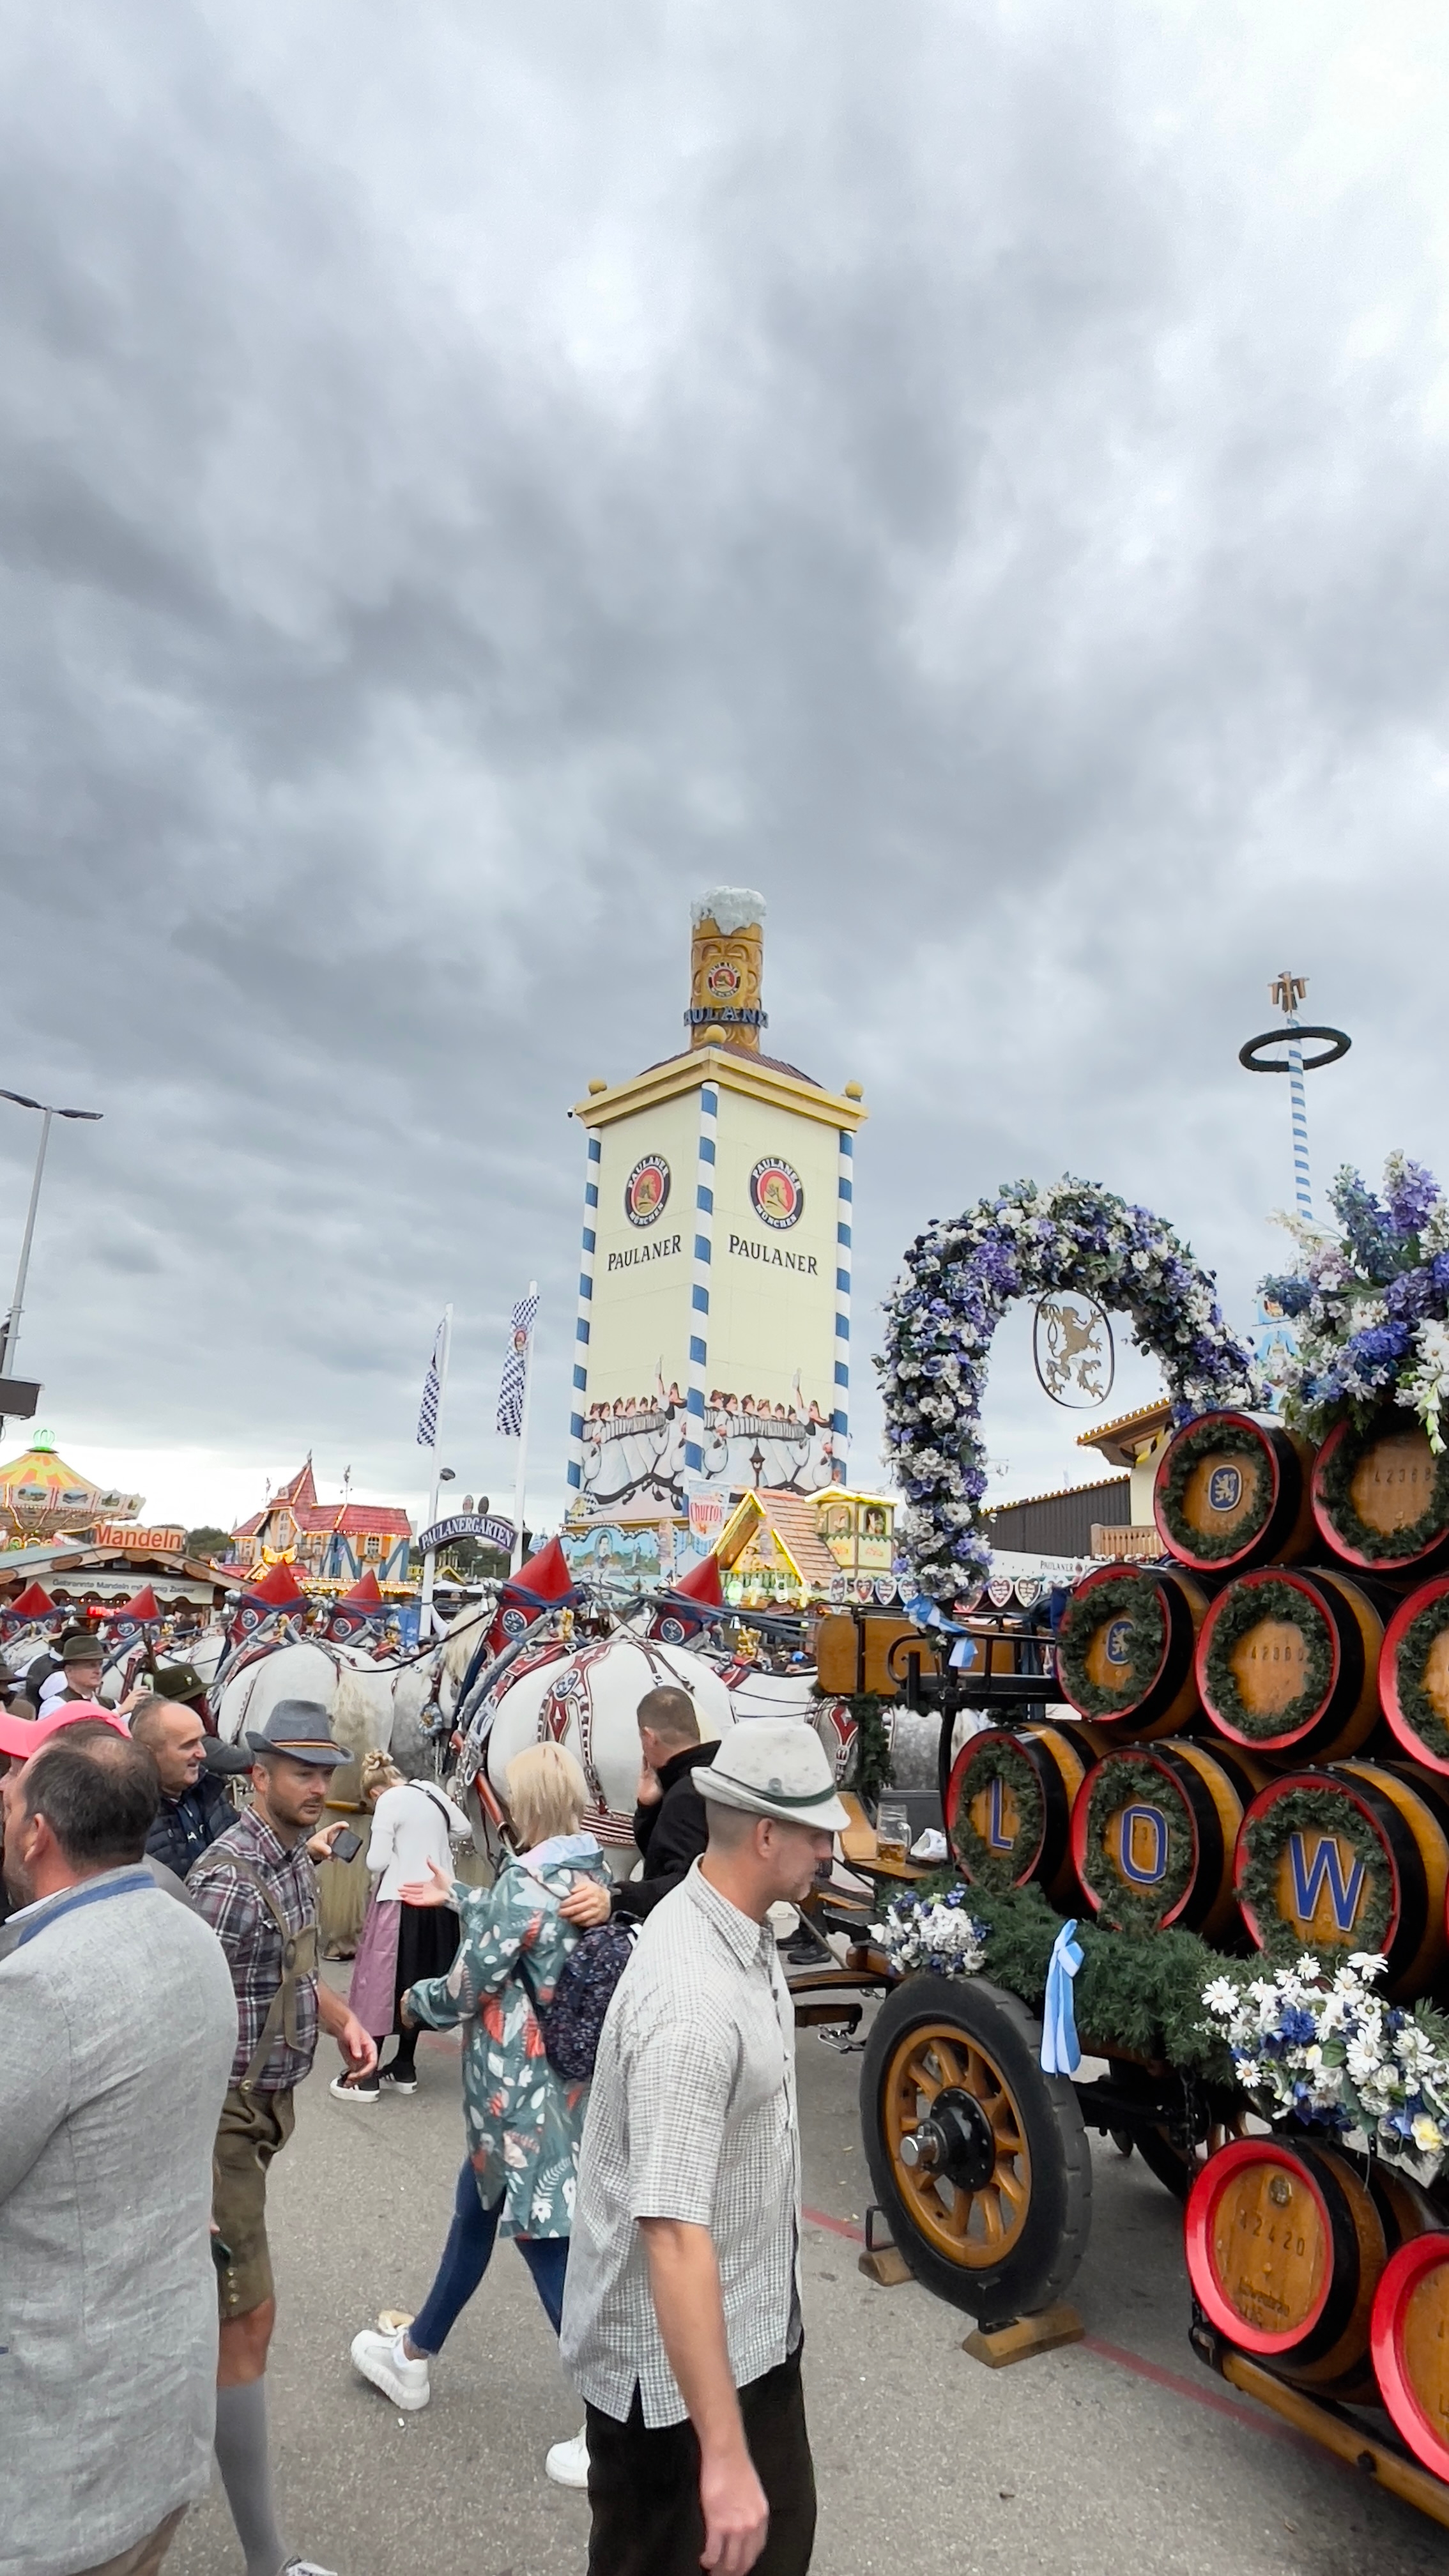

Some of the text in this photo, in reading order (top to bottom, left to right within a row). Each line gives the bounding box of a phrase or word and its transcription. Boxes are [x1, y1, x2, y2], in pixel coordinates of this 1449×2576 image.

[627, 1156, 670, 1188] PAULANER
[752, 1158, 801, 1190] PAULANER
[608, 1234, 681, 1271] PAULANER
[729, 1234, 818, 1275] PAULANER
[94, 1524, 181, 1549] Mandeln
[422, 1517, 514, 1550] PAULANERGARTEN
[1040, 1560, 1073, 1572] PAULANER
[96, 1581, 129, 1590] Mandeln
[991, 1777, 1014, 1850] L
[1289, 1832, 1365, 1932] W
